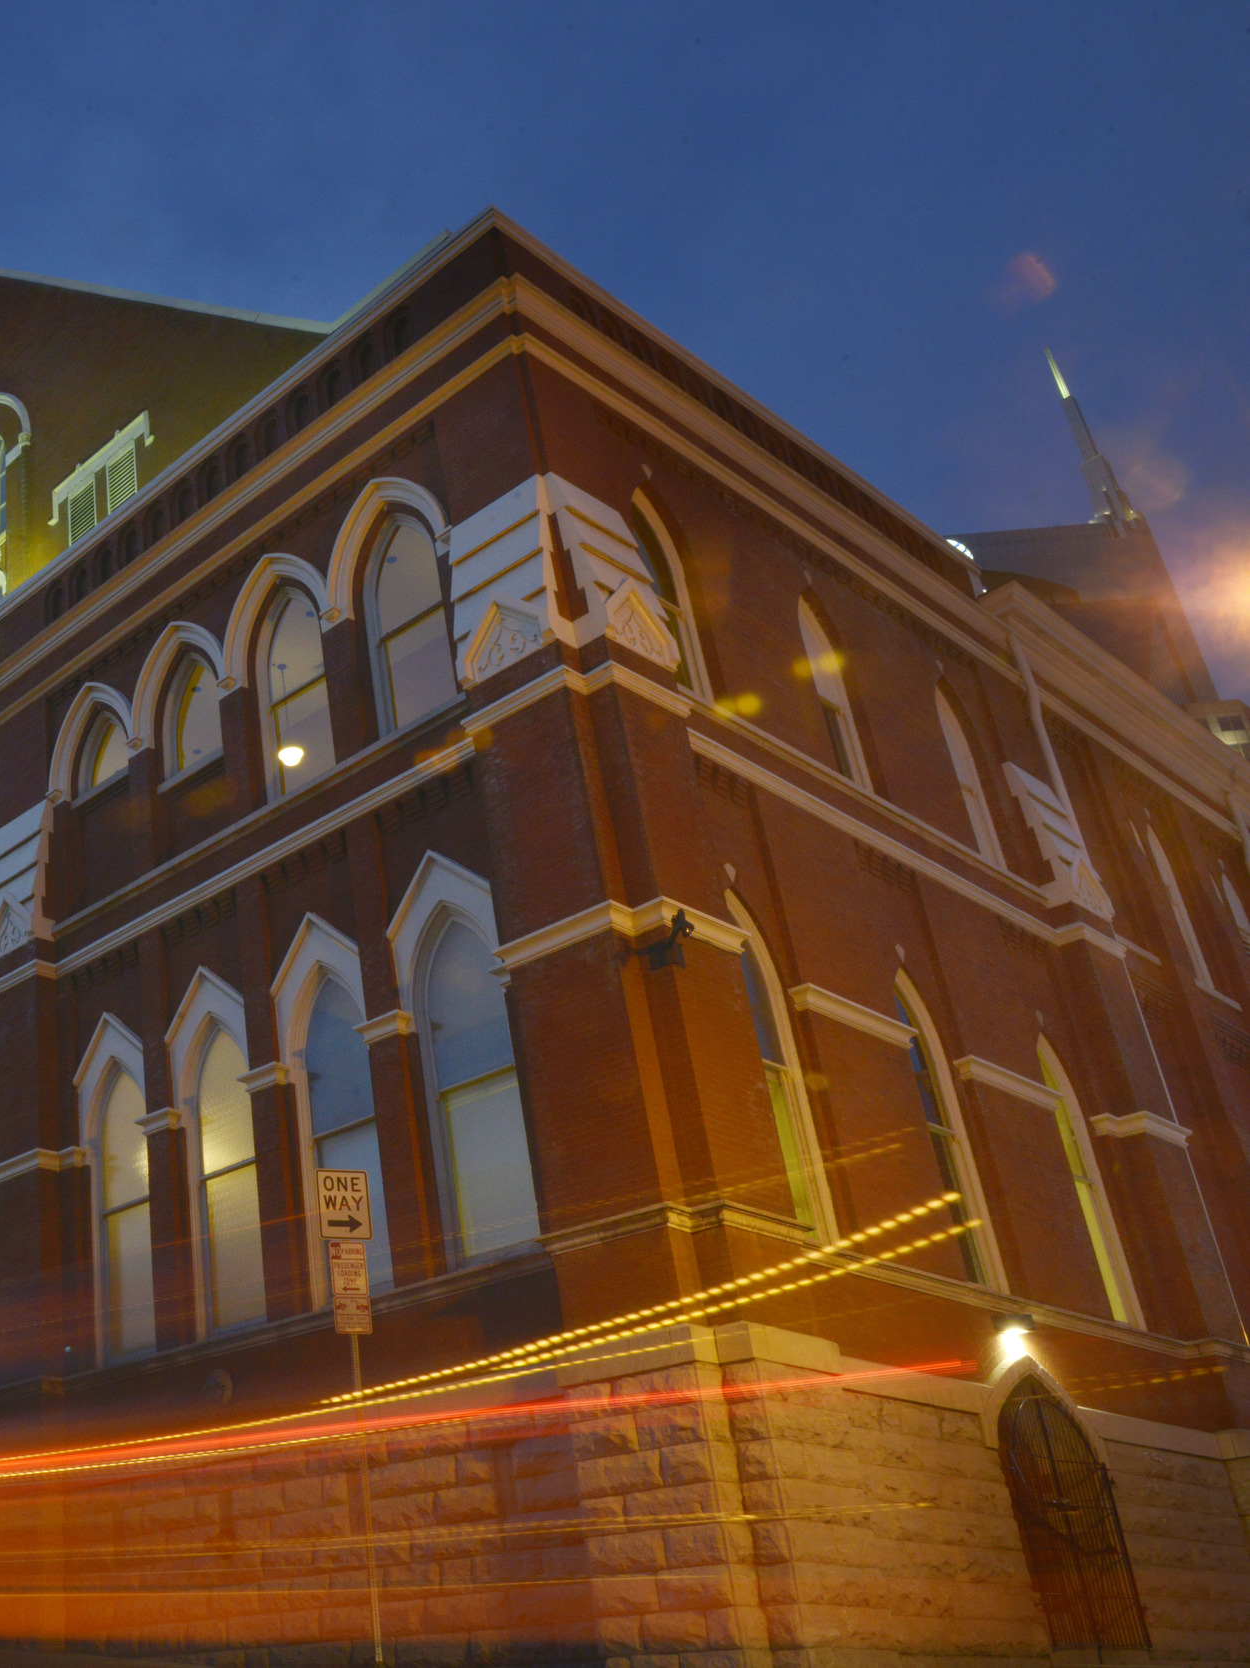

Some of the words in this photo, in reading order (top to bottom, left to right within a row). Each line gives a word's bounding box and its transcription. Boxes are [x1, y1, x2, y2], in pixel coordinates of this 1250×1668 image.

[323, 1176, 361, 1192] ONE
[323, 1195, 363, 1211] WAY
[330, 1246, 341, 1257] NO
[341, 1247, 363, 1256] PARKING
